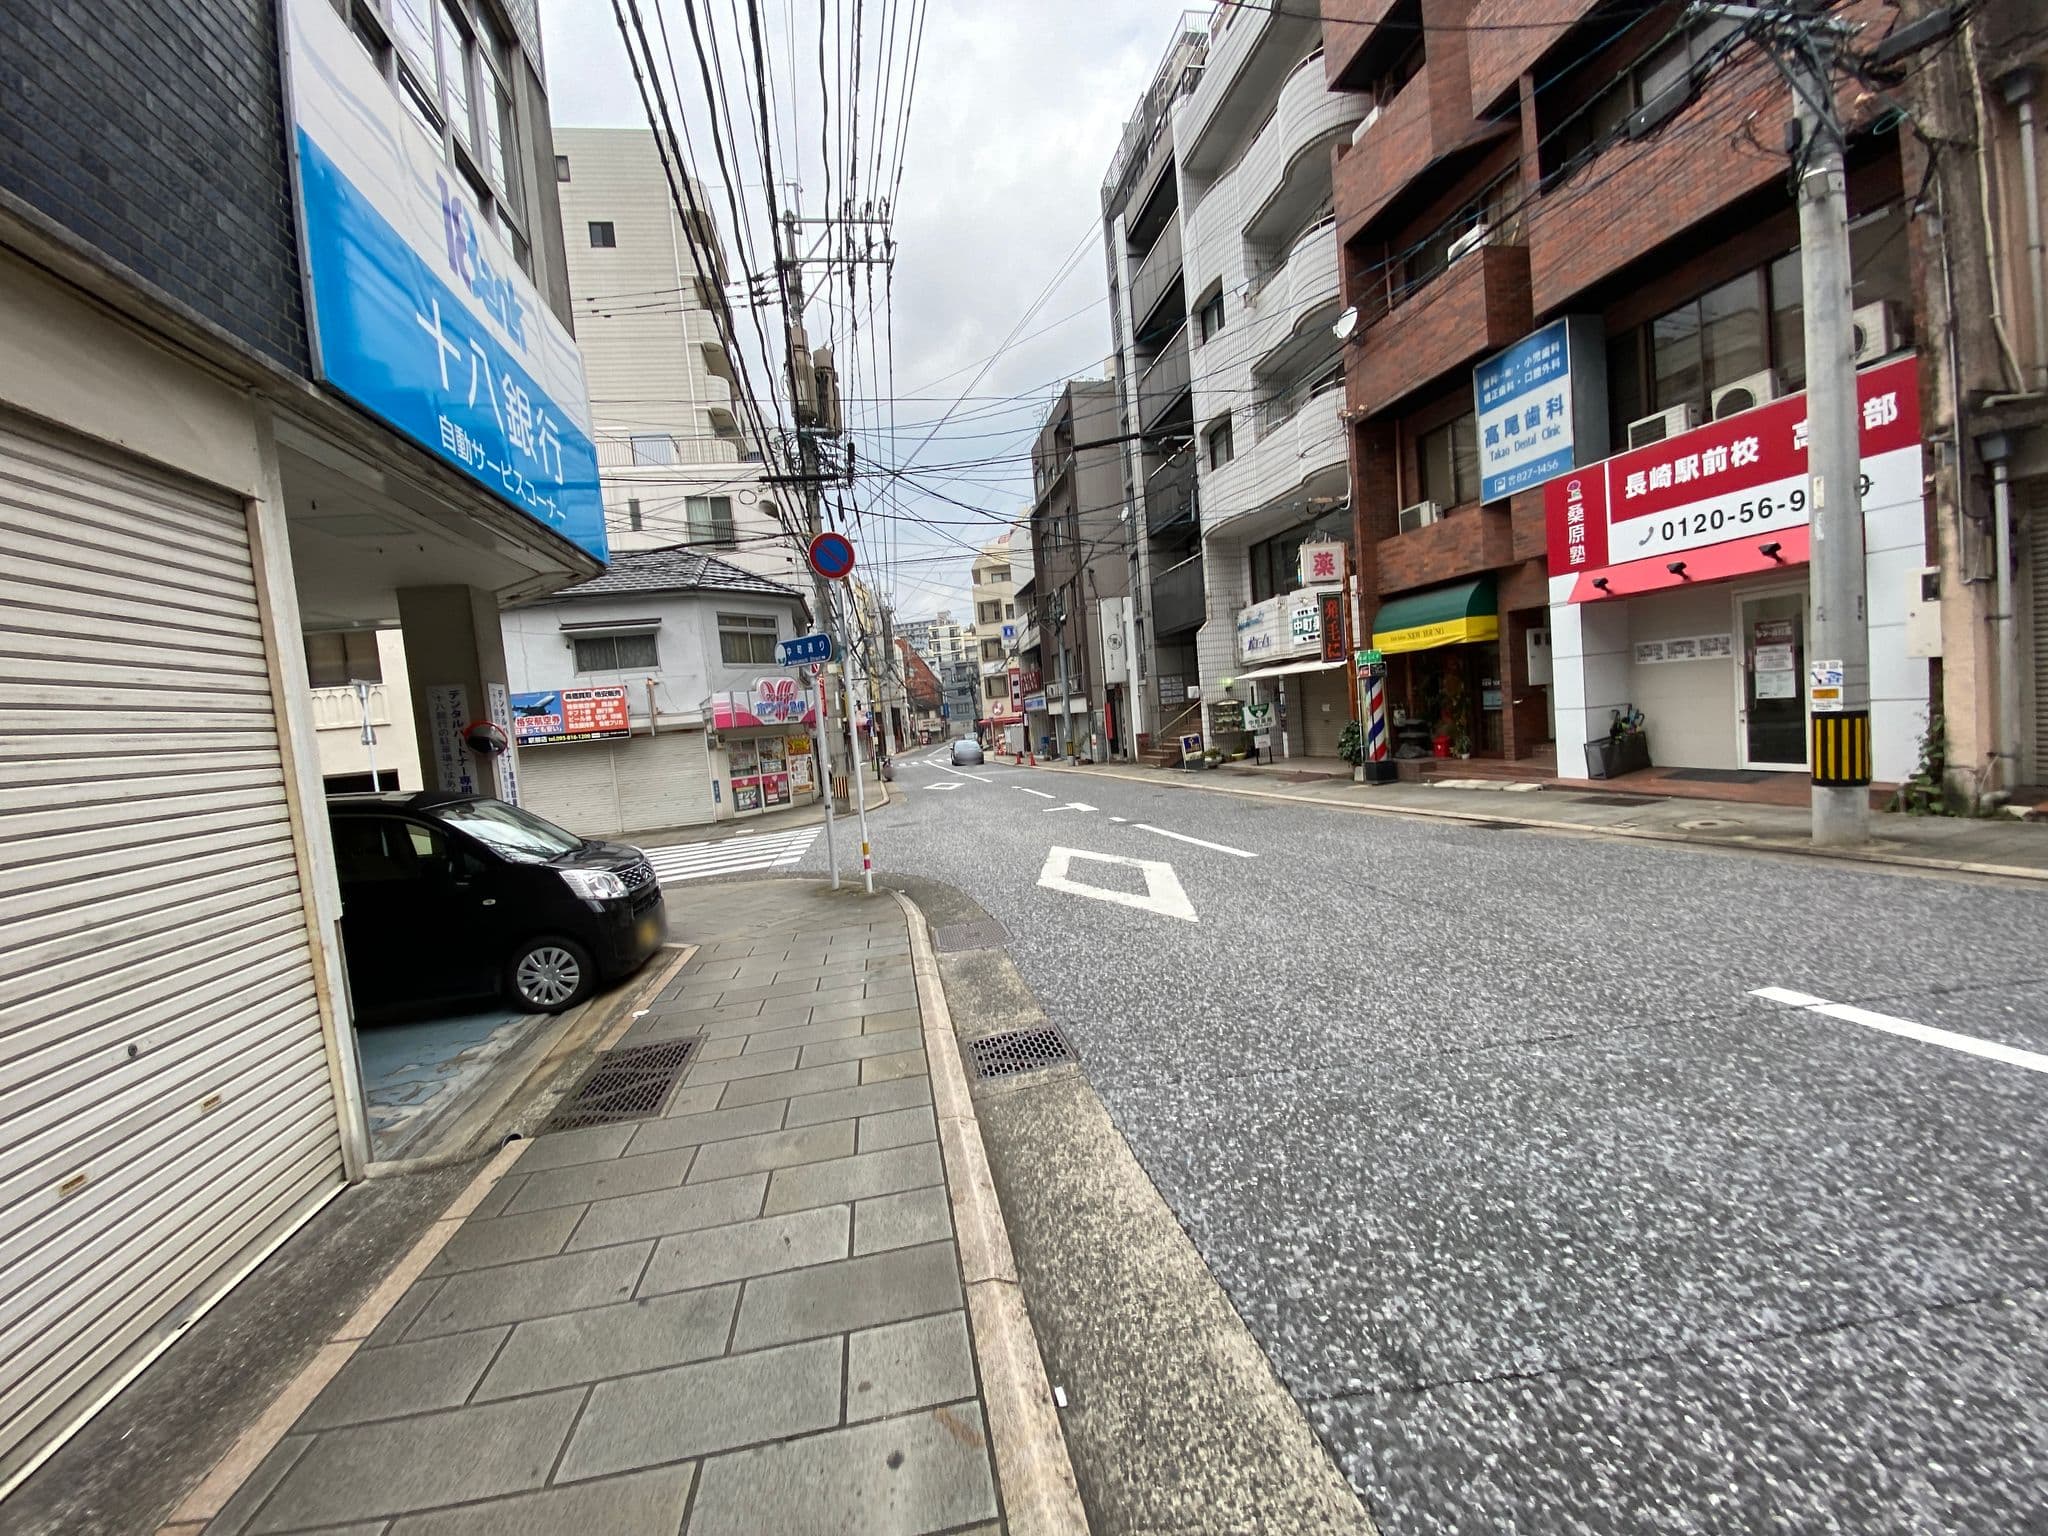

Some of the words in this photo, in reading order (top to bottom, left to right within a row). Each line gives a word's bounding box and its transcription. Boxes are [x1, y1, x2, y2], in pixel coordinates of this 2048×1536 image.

[416, 297, 565, 485] 十八銀行
[1484, 393, 1563, 448] 高尾歯科
[438, 414, 566, 521] 自動サービスコーナー
[1490, 447, 1510, 462] Takao
[1514, 433, 1537, 451] Dental
[1541, 424, 1561, 440] Clinic
[1624, 436, 1760, 500] 長崎駅前校
[1792, 391, 1898, 452] 高部
[1567, 502, 1586, 565] 桑原塾
[1661, 473, 1870, 542] 0120-56-99
[1313, 551, 1335, 576] 薬
[516, 715, 561, 727] 格安航空券
